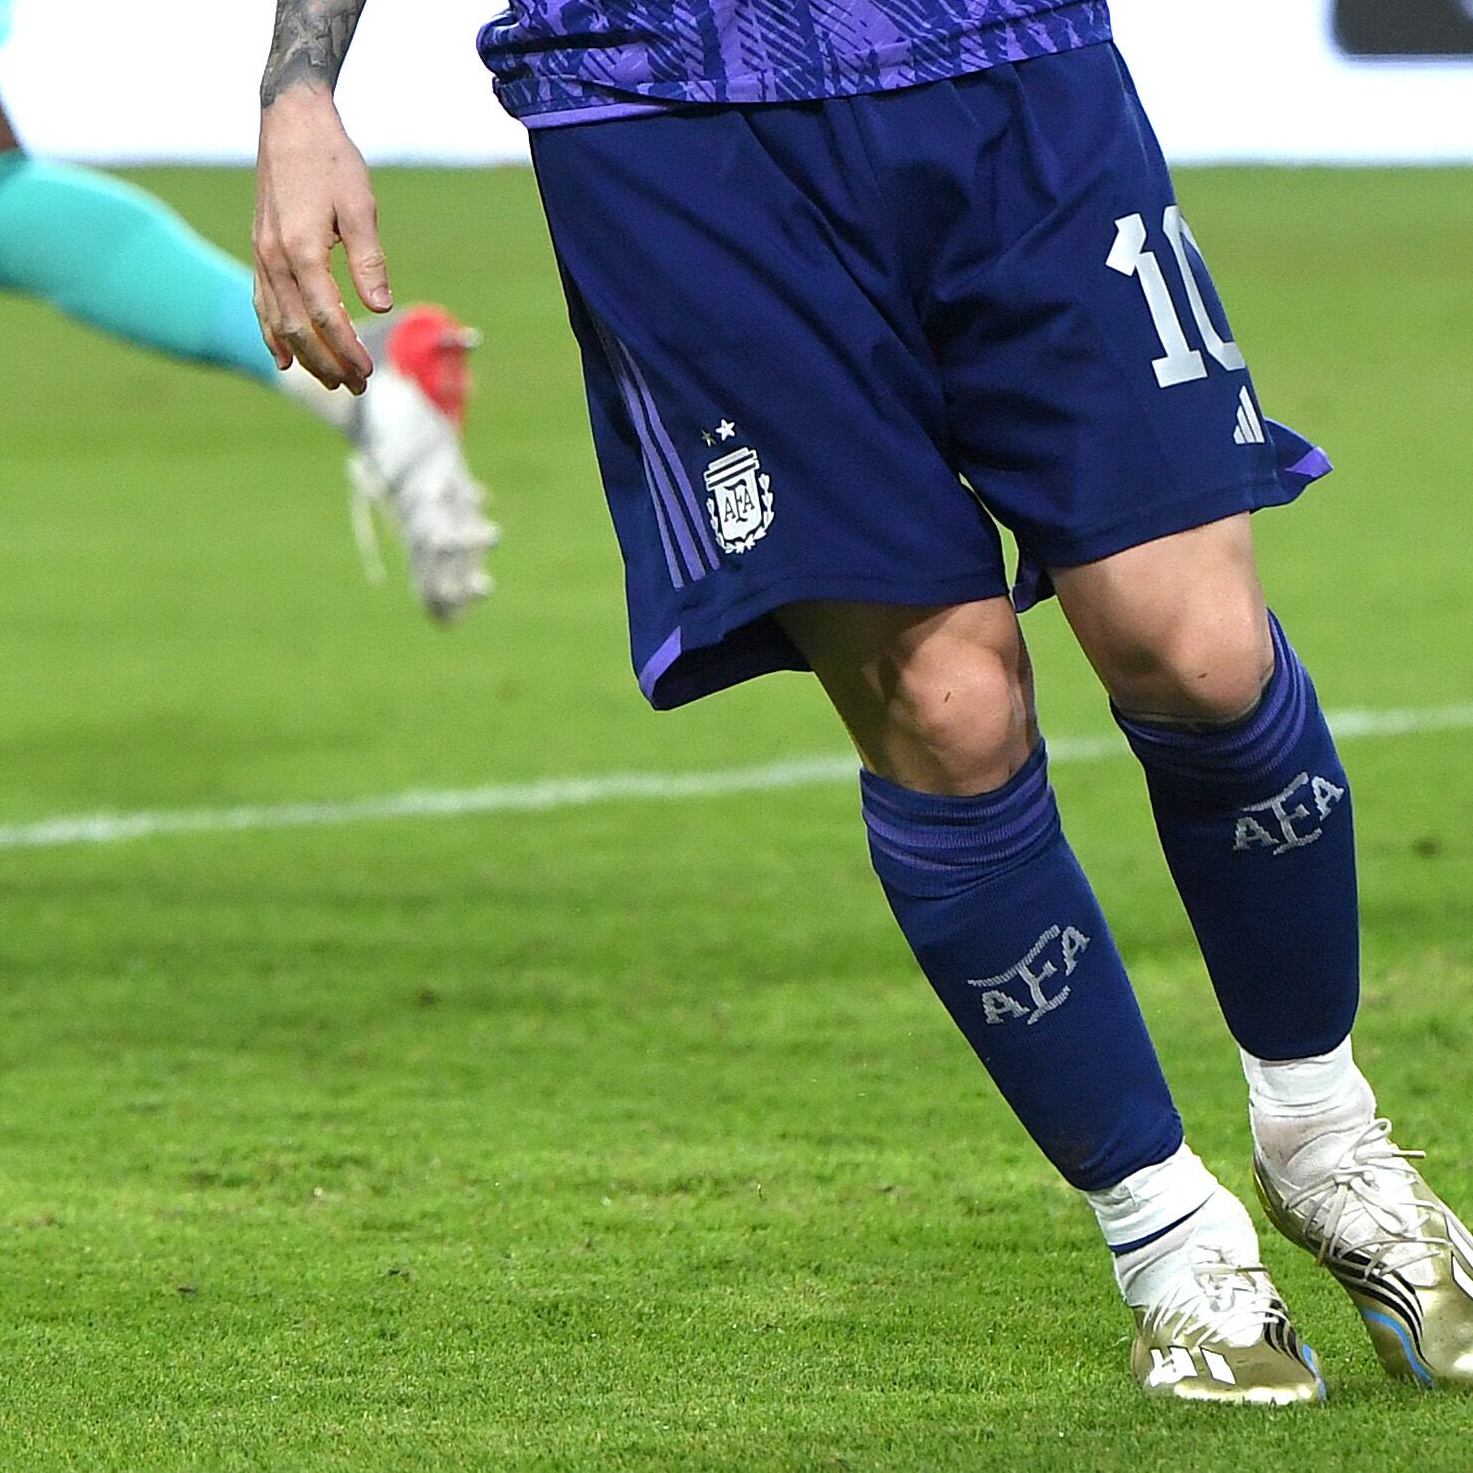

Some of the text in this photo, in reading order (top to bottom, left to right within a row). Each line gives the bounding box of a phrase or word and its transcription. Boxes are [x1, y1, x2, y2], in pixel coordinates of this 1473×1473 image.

[724, 478, 755, 523] AFA
[1232, 771, 1346, 856] AFA
[967, 924, 1091, 1026] AFA
